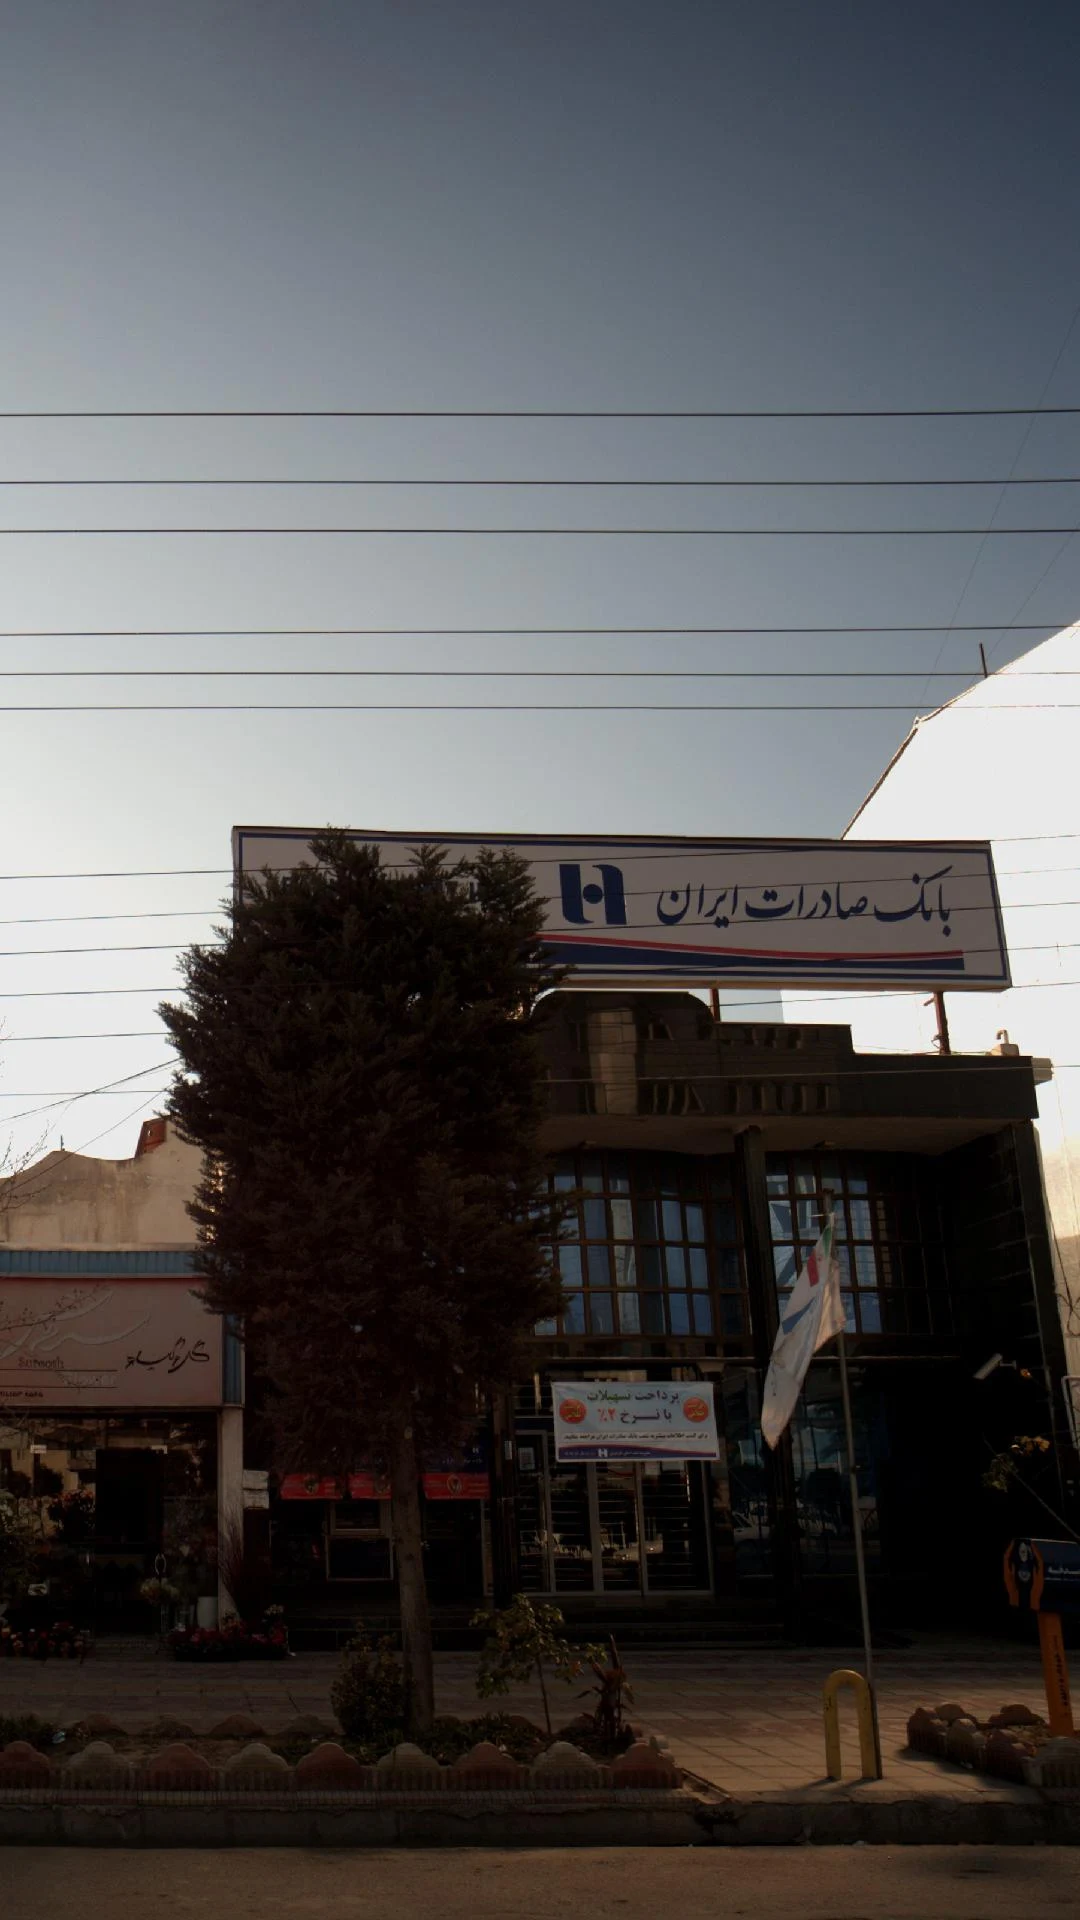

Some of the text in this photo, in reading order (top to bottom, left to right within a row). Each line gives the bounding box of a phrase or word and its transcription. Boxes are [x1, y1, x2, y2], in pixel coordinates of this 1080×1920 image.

[656, 865, 953, 937] بانک صادرات ایران
[663, 1408, 672, 1423] با
